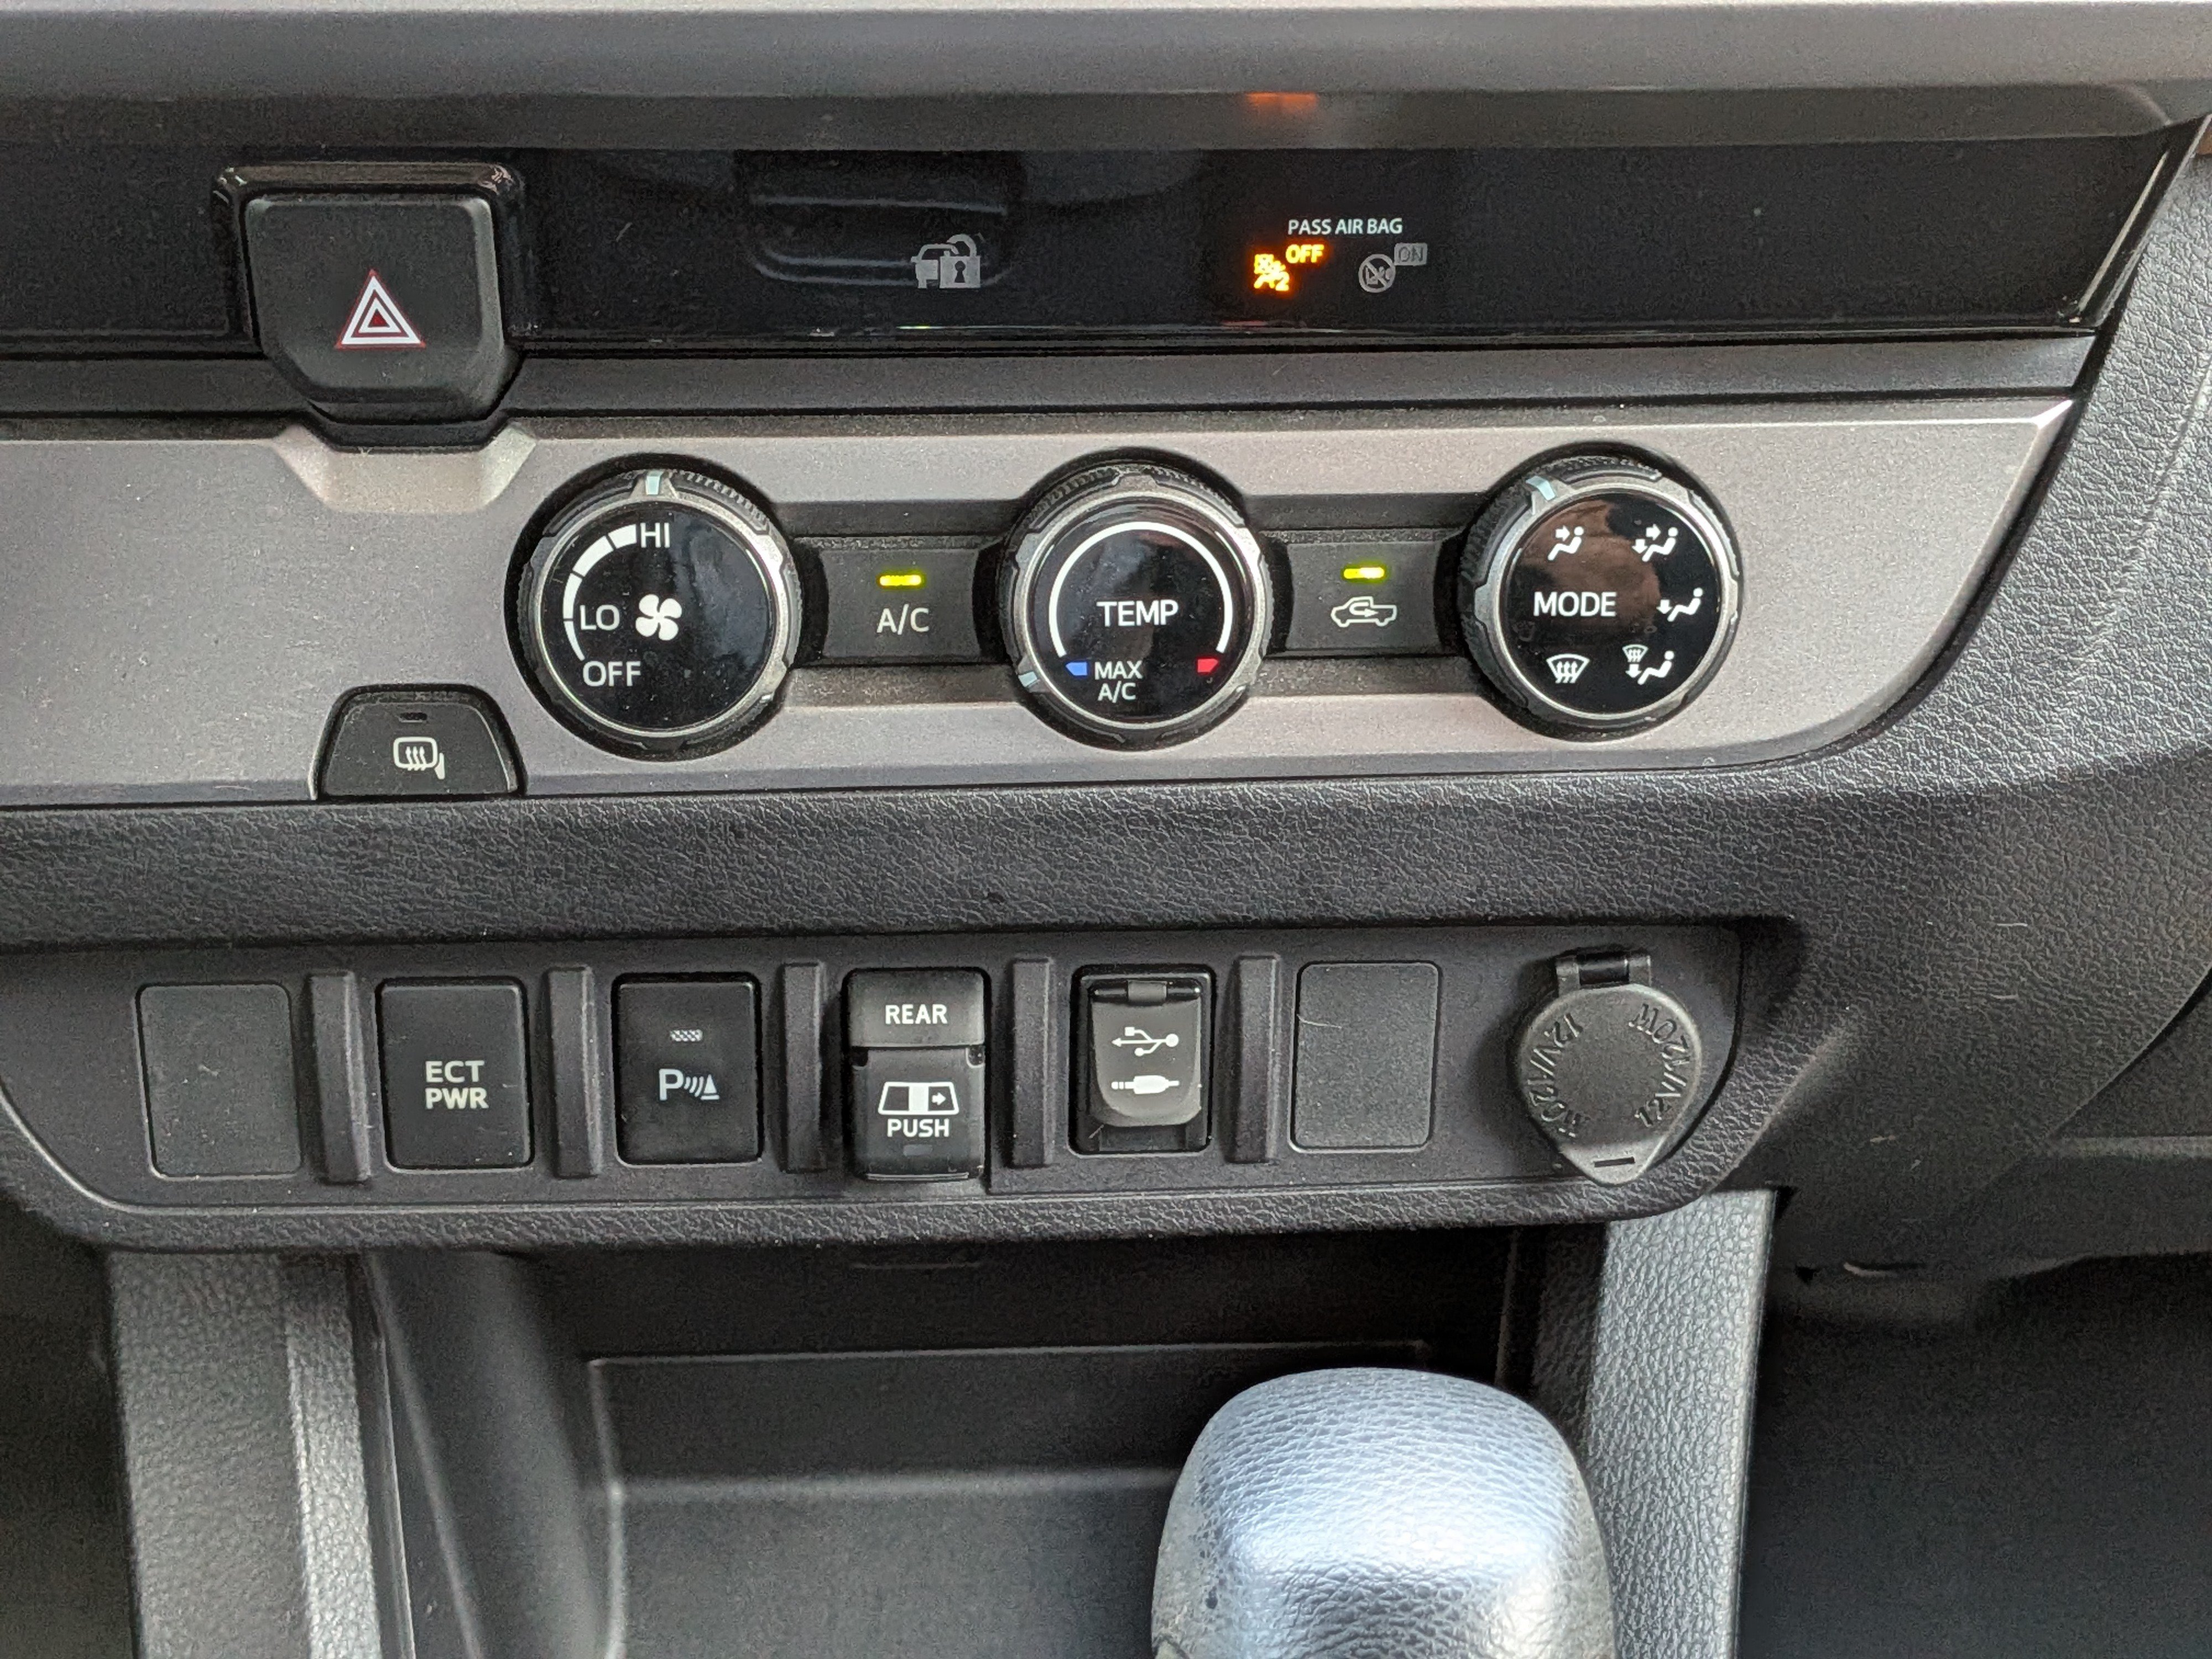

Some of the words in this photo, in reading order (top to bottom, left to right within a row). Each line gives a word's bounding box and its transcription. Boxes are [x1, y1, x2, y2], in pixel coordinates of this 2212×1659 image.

[1287, 219, 1331, 235] PASS
[1334, 218, 1363, 234] AIR
[1366, 217, 1404, 234] BAG
[1285, 244, 1324, 264] OFF
[1398, 247, 1423, 262] ON
[640, 523, 670, 548] HI
[1096, 599, 1179, 627] TEMP
[1532, 591, 1618, 617] MODE
[580, 604, 620, 631] LO
[877, 604, 930, 634] A/C
[582, 660, 641, 687] OFF
[1094, 661, 1143, 680] MAX
[1098, 682, 1136, 703] A/C
[884, 1004, 948, 1025] REAR
[425, 1060, 485, 1083] ECT
[425, 1087, 489, 1110] PWR
[886, 1118, 950, 1138] PUSH
